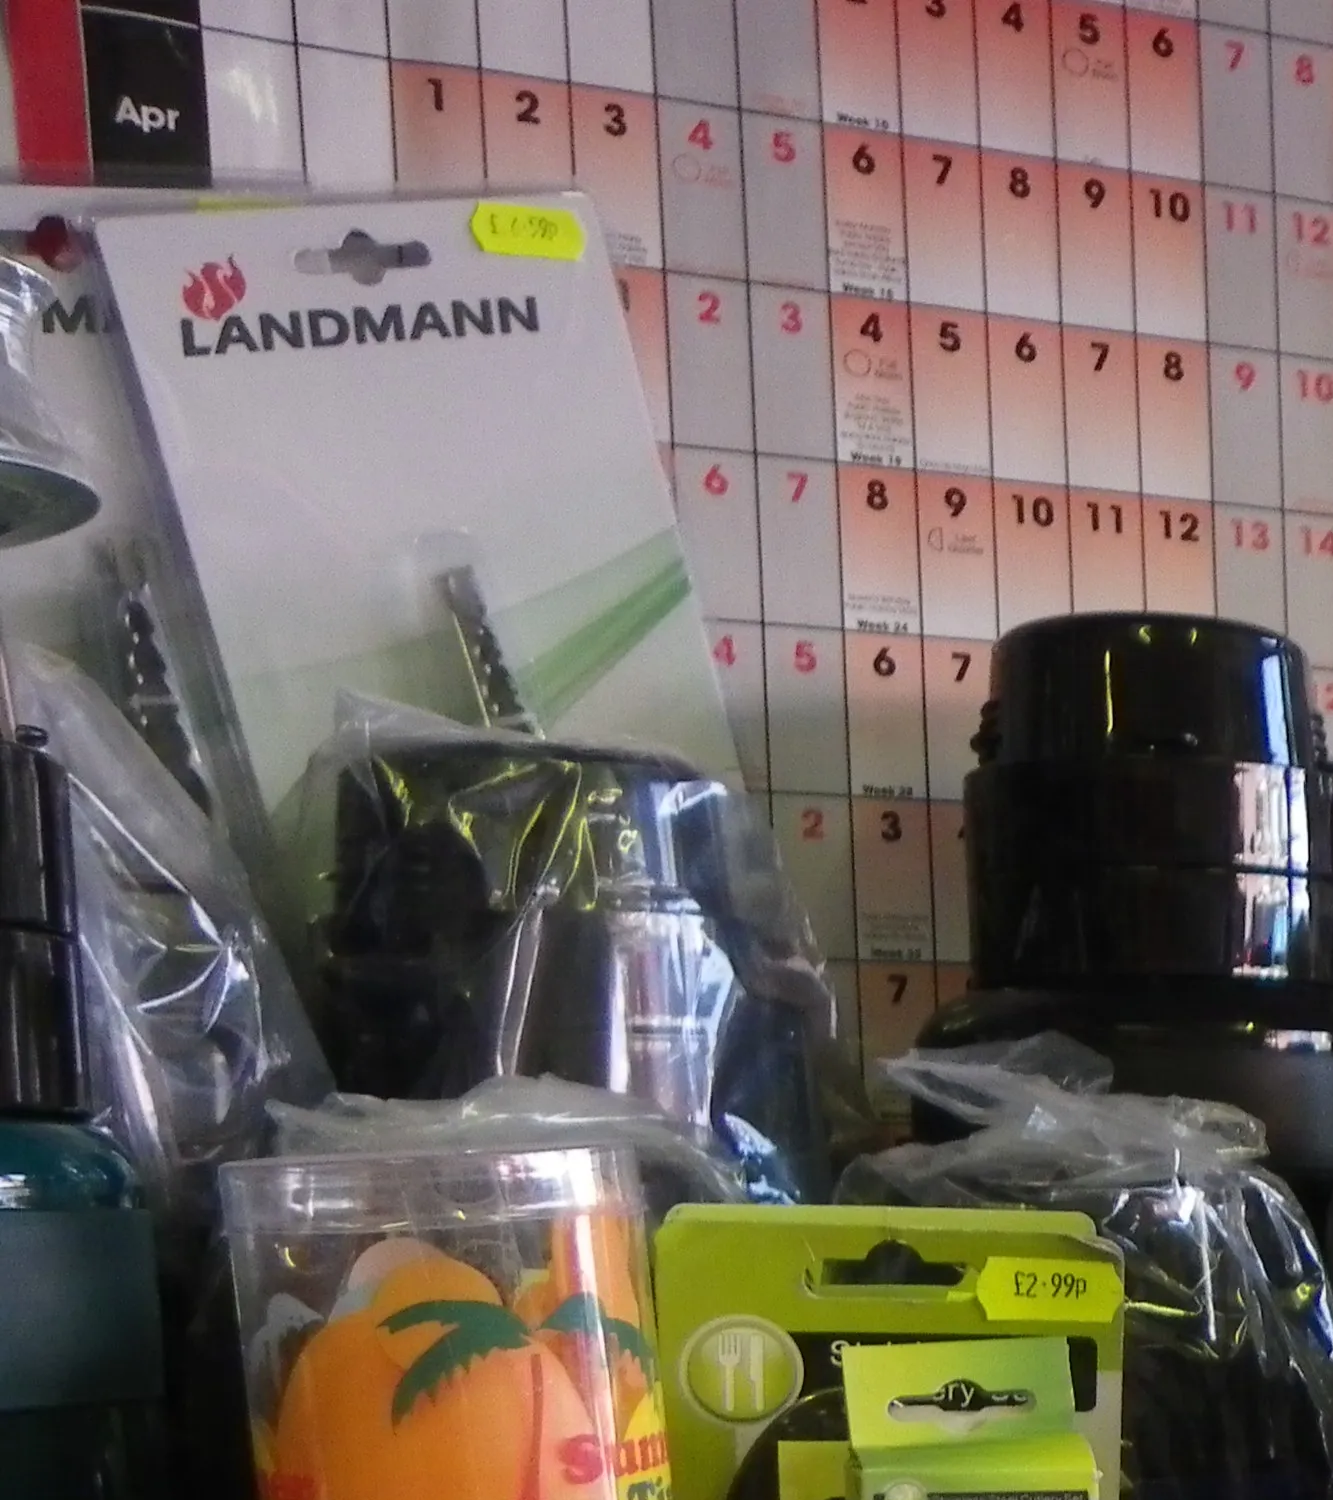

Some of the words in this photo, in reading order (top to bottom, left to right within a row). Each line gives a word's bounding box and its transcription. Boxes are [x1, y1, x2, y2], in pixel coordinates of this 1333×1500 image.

[1079, 13, 1100, 45] 5
[115, 95, 180, 133] Apr
[427, 78, 443, 112] 1
[516, 90, 540, 125] 2
[604, 103, 627, 137] 3
[852, 144, 875, 175] 6
[933, 154, 952, 186] 7
[1084, 179, 1105, 209] 9
[1150, 189, 1190, 223] 10
[179, 296, 540, 358] LANDMANN
[698, 291, 720, 324] 2
[860, 313, 882, 343] 4
[1015, 333, 1037, 363] 6
[1164, 351, 1184, 382] 8
[866, 480, 888, 511] 8
[1012, 495, 1054, 527] 10
[1160, 511, 1199, 542] 12
[873, 647, 896, 677] 6
[881, 811, 902, 843] 3
[888, 974, 907, 1005] 7
